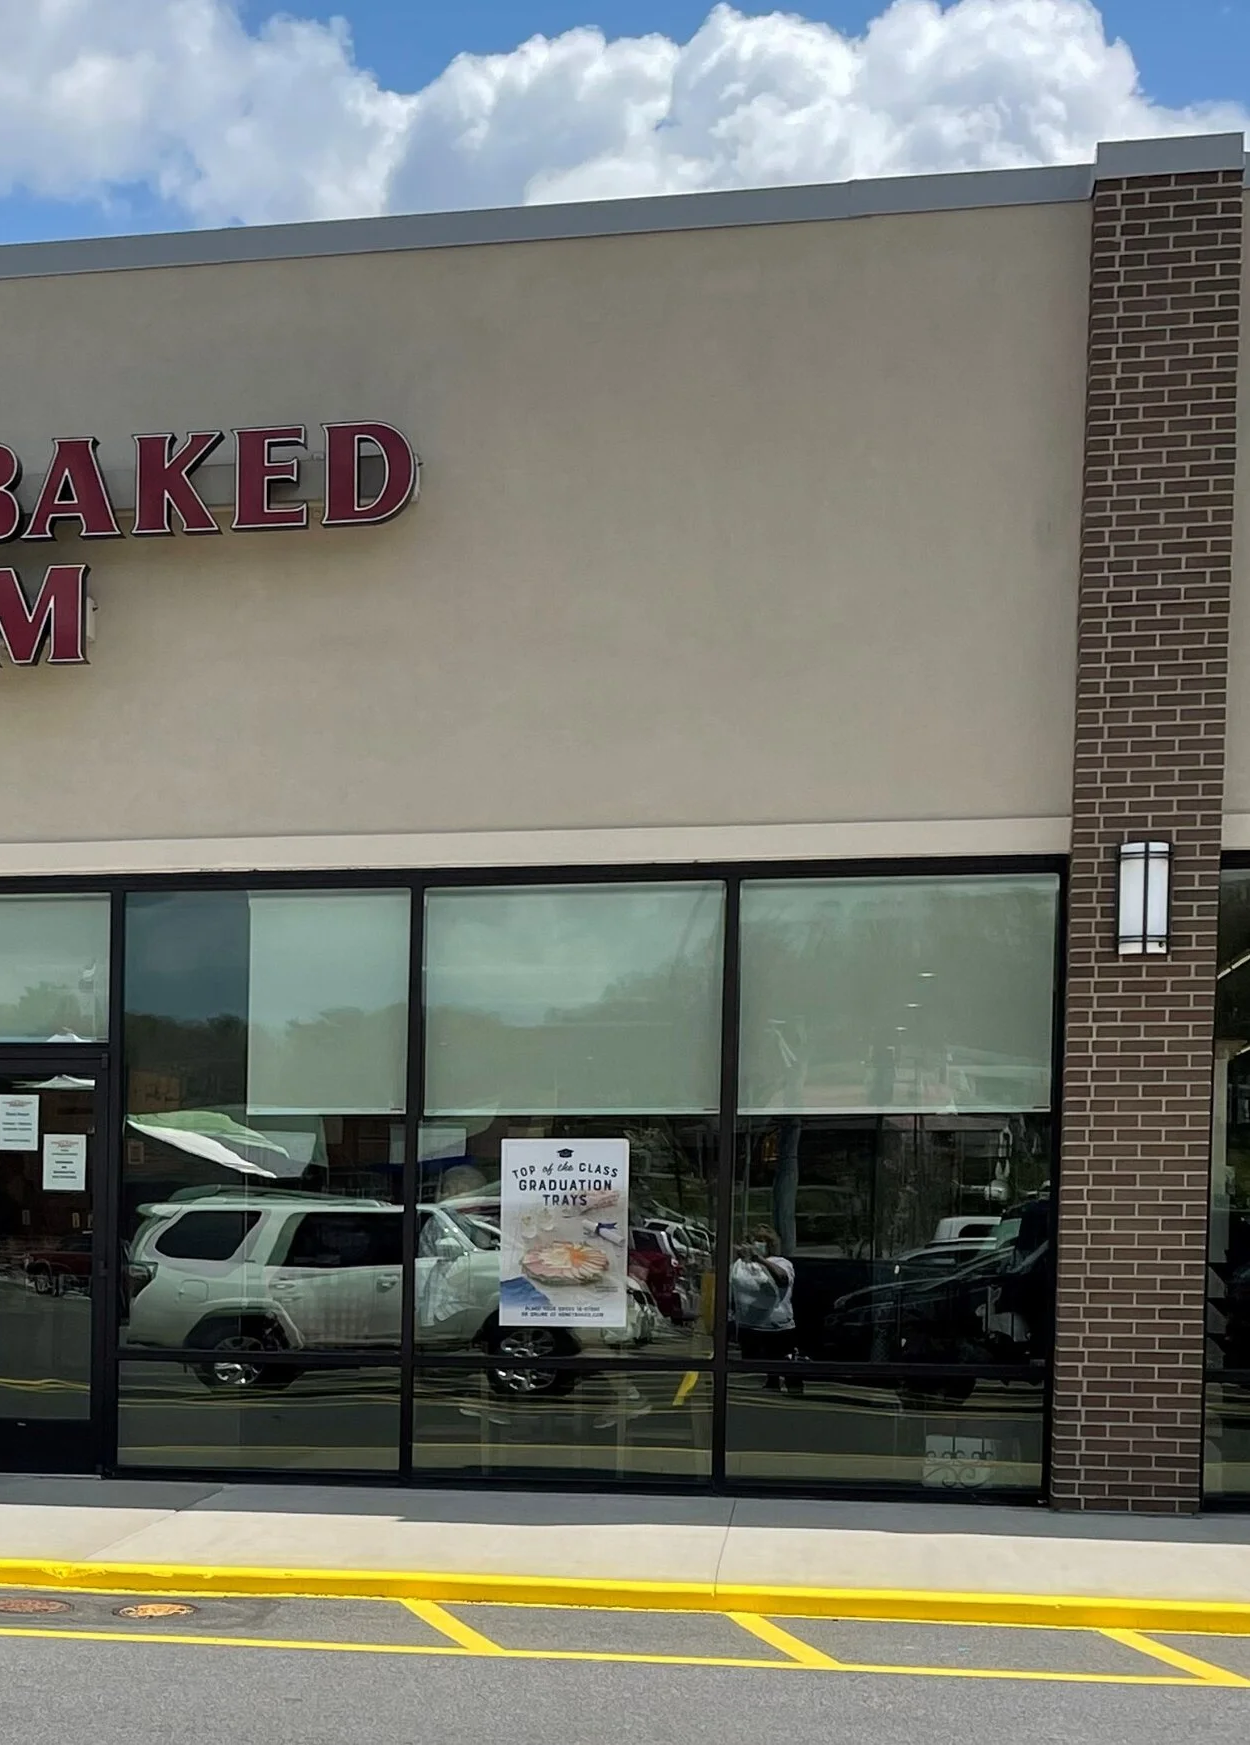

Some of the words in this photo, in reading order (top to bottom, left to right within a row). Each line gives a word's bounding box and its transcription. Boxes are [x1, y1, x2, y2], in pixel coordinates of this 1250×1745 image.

[512, 1165, 536, 1179] TOP
[542, 1163, 554, 1176] of
[557, 1161, 574, 1172] the
[578, 1162, 618, 1178] CLASS
[519, 1179, 612, 1191] GRADUATION
[542, 1194, 587, 1206] TRAYS
